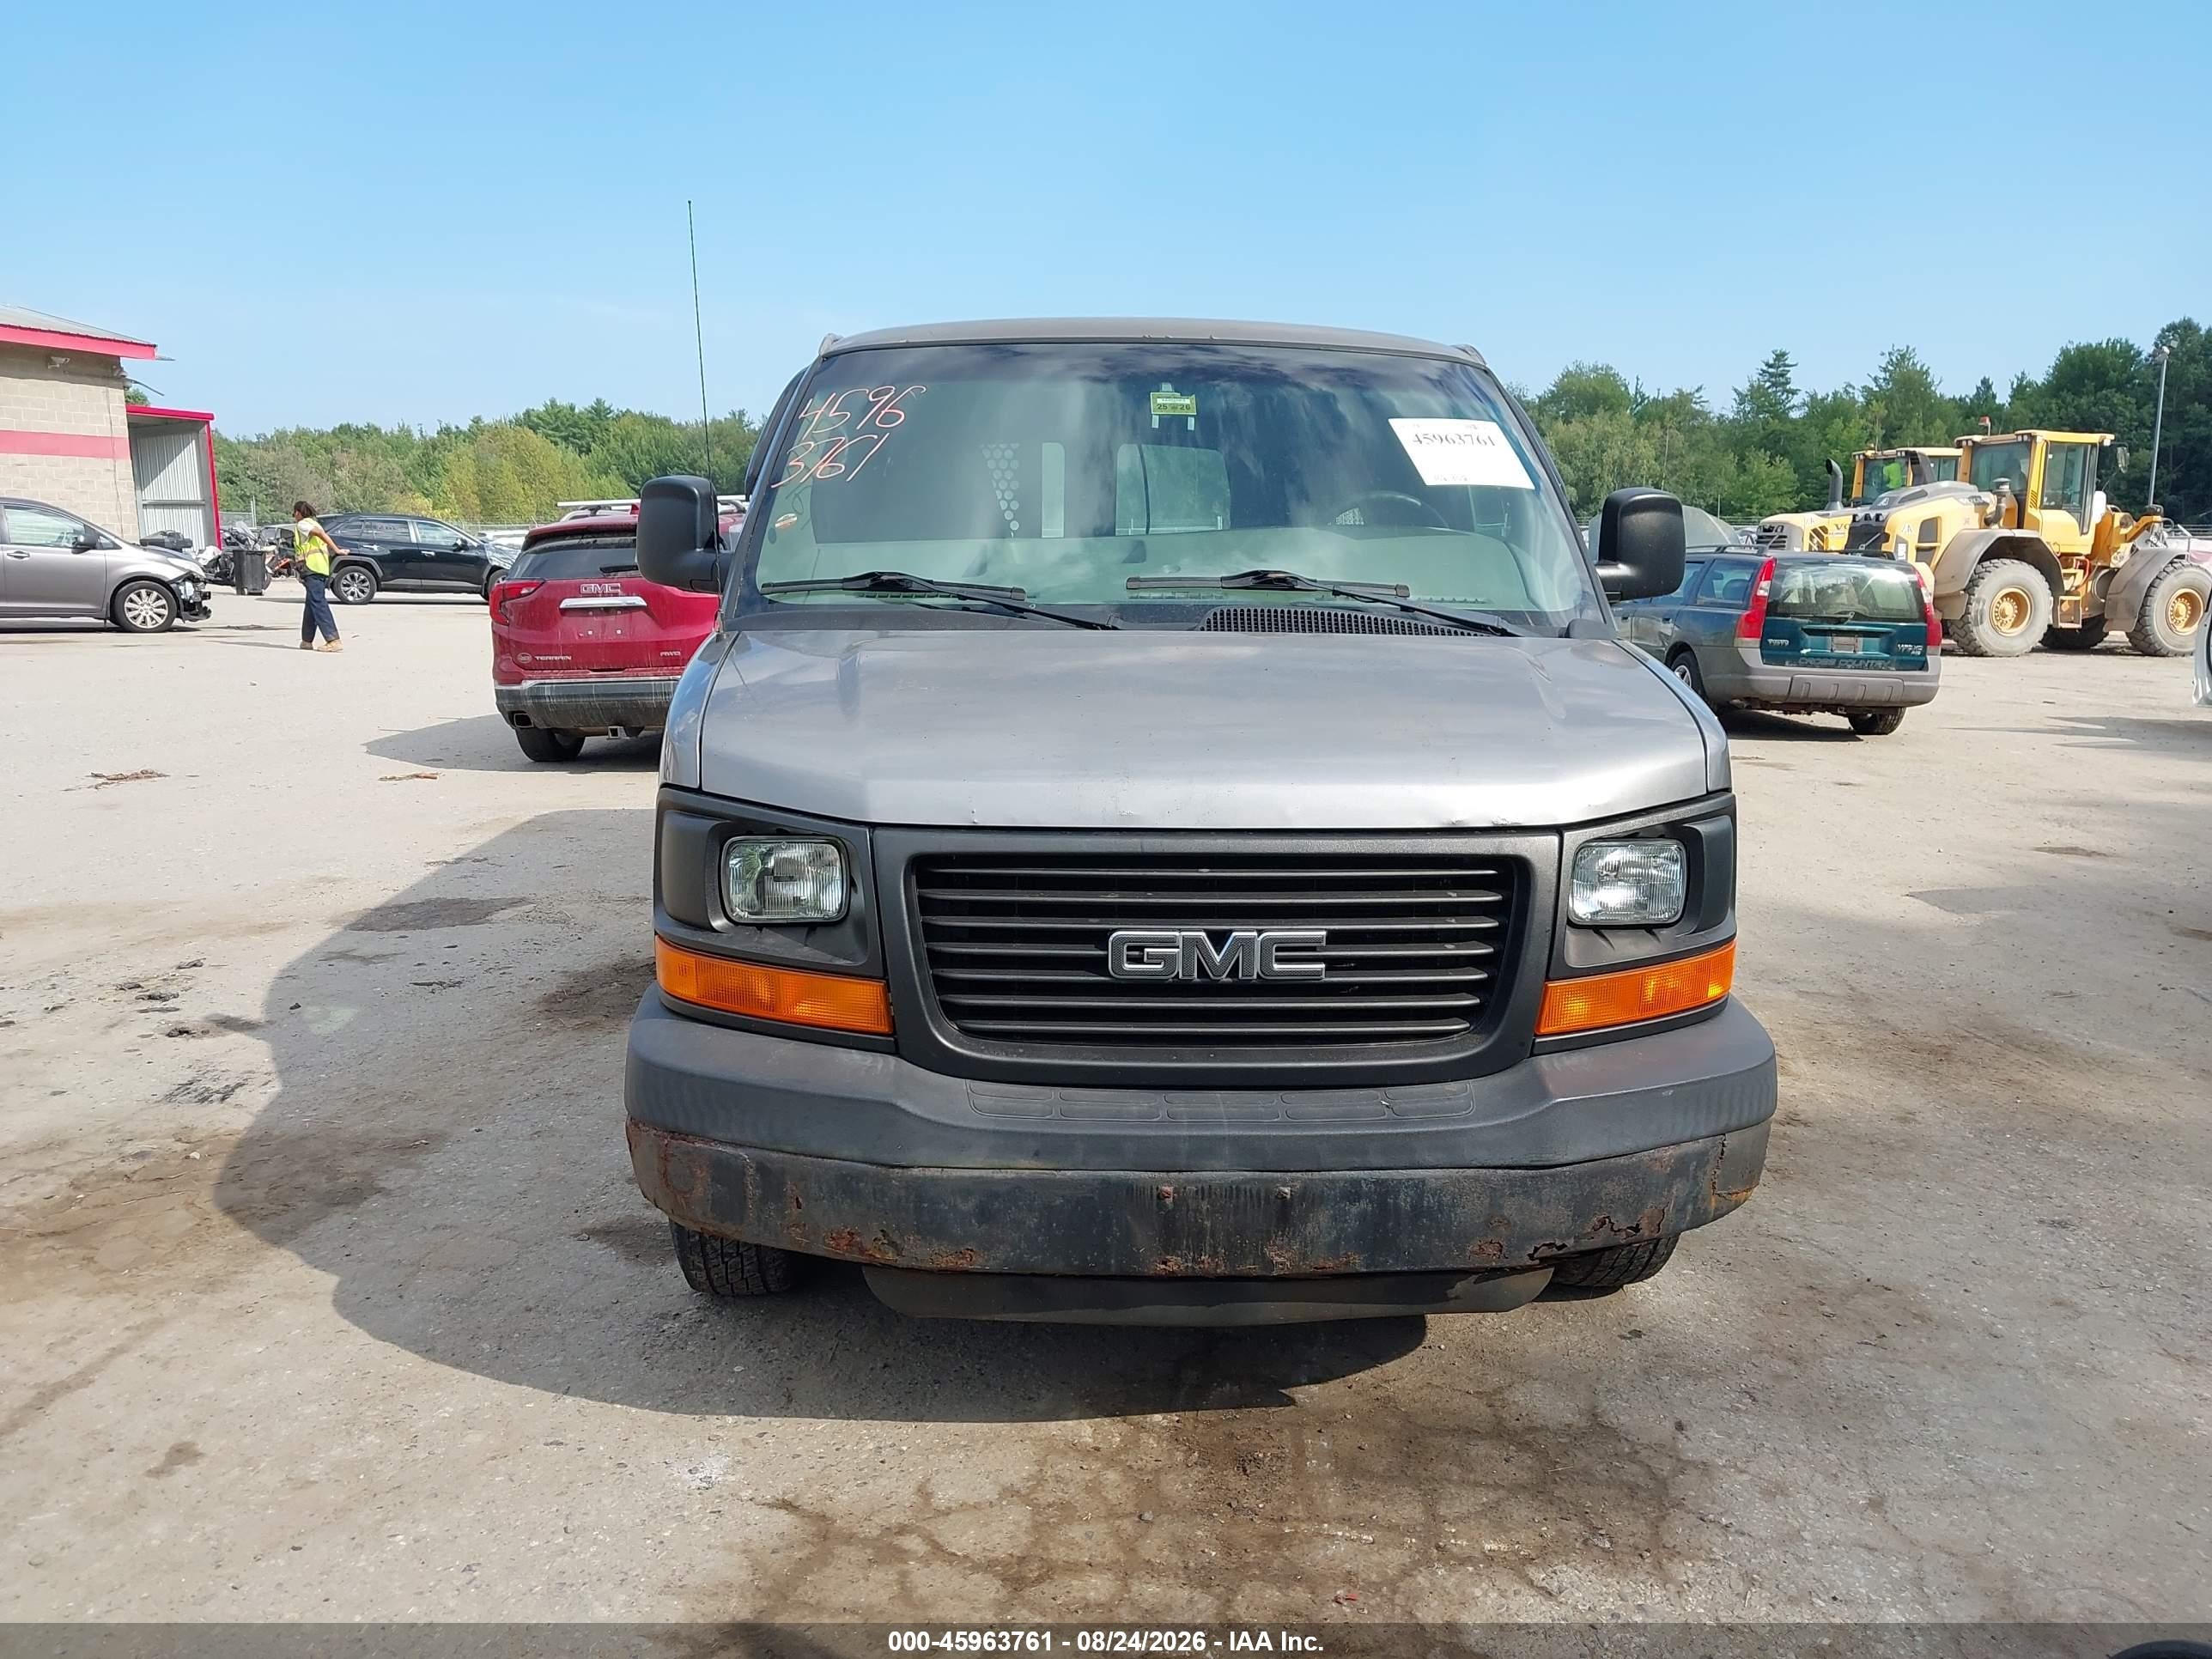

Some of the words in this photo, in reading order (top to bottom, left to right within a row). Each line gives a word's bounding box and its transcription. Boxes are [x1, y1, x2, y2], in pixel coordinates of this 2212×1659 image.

[799, 386, 927, 440] 4596
[1412, 433, 1496, 447] 45963761
[771, 433, 890, 488] 3761
[580, 583, 621, 594] GMC
[1838, 658, 1893, 669] COUNTRY
[1108, 930, 1328, 981] GMC
